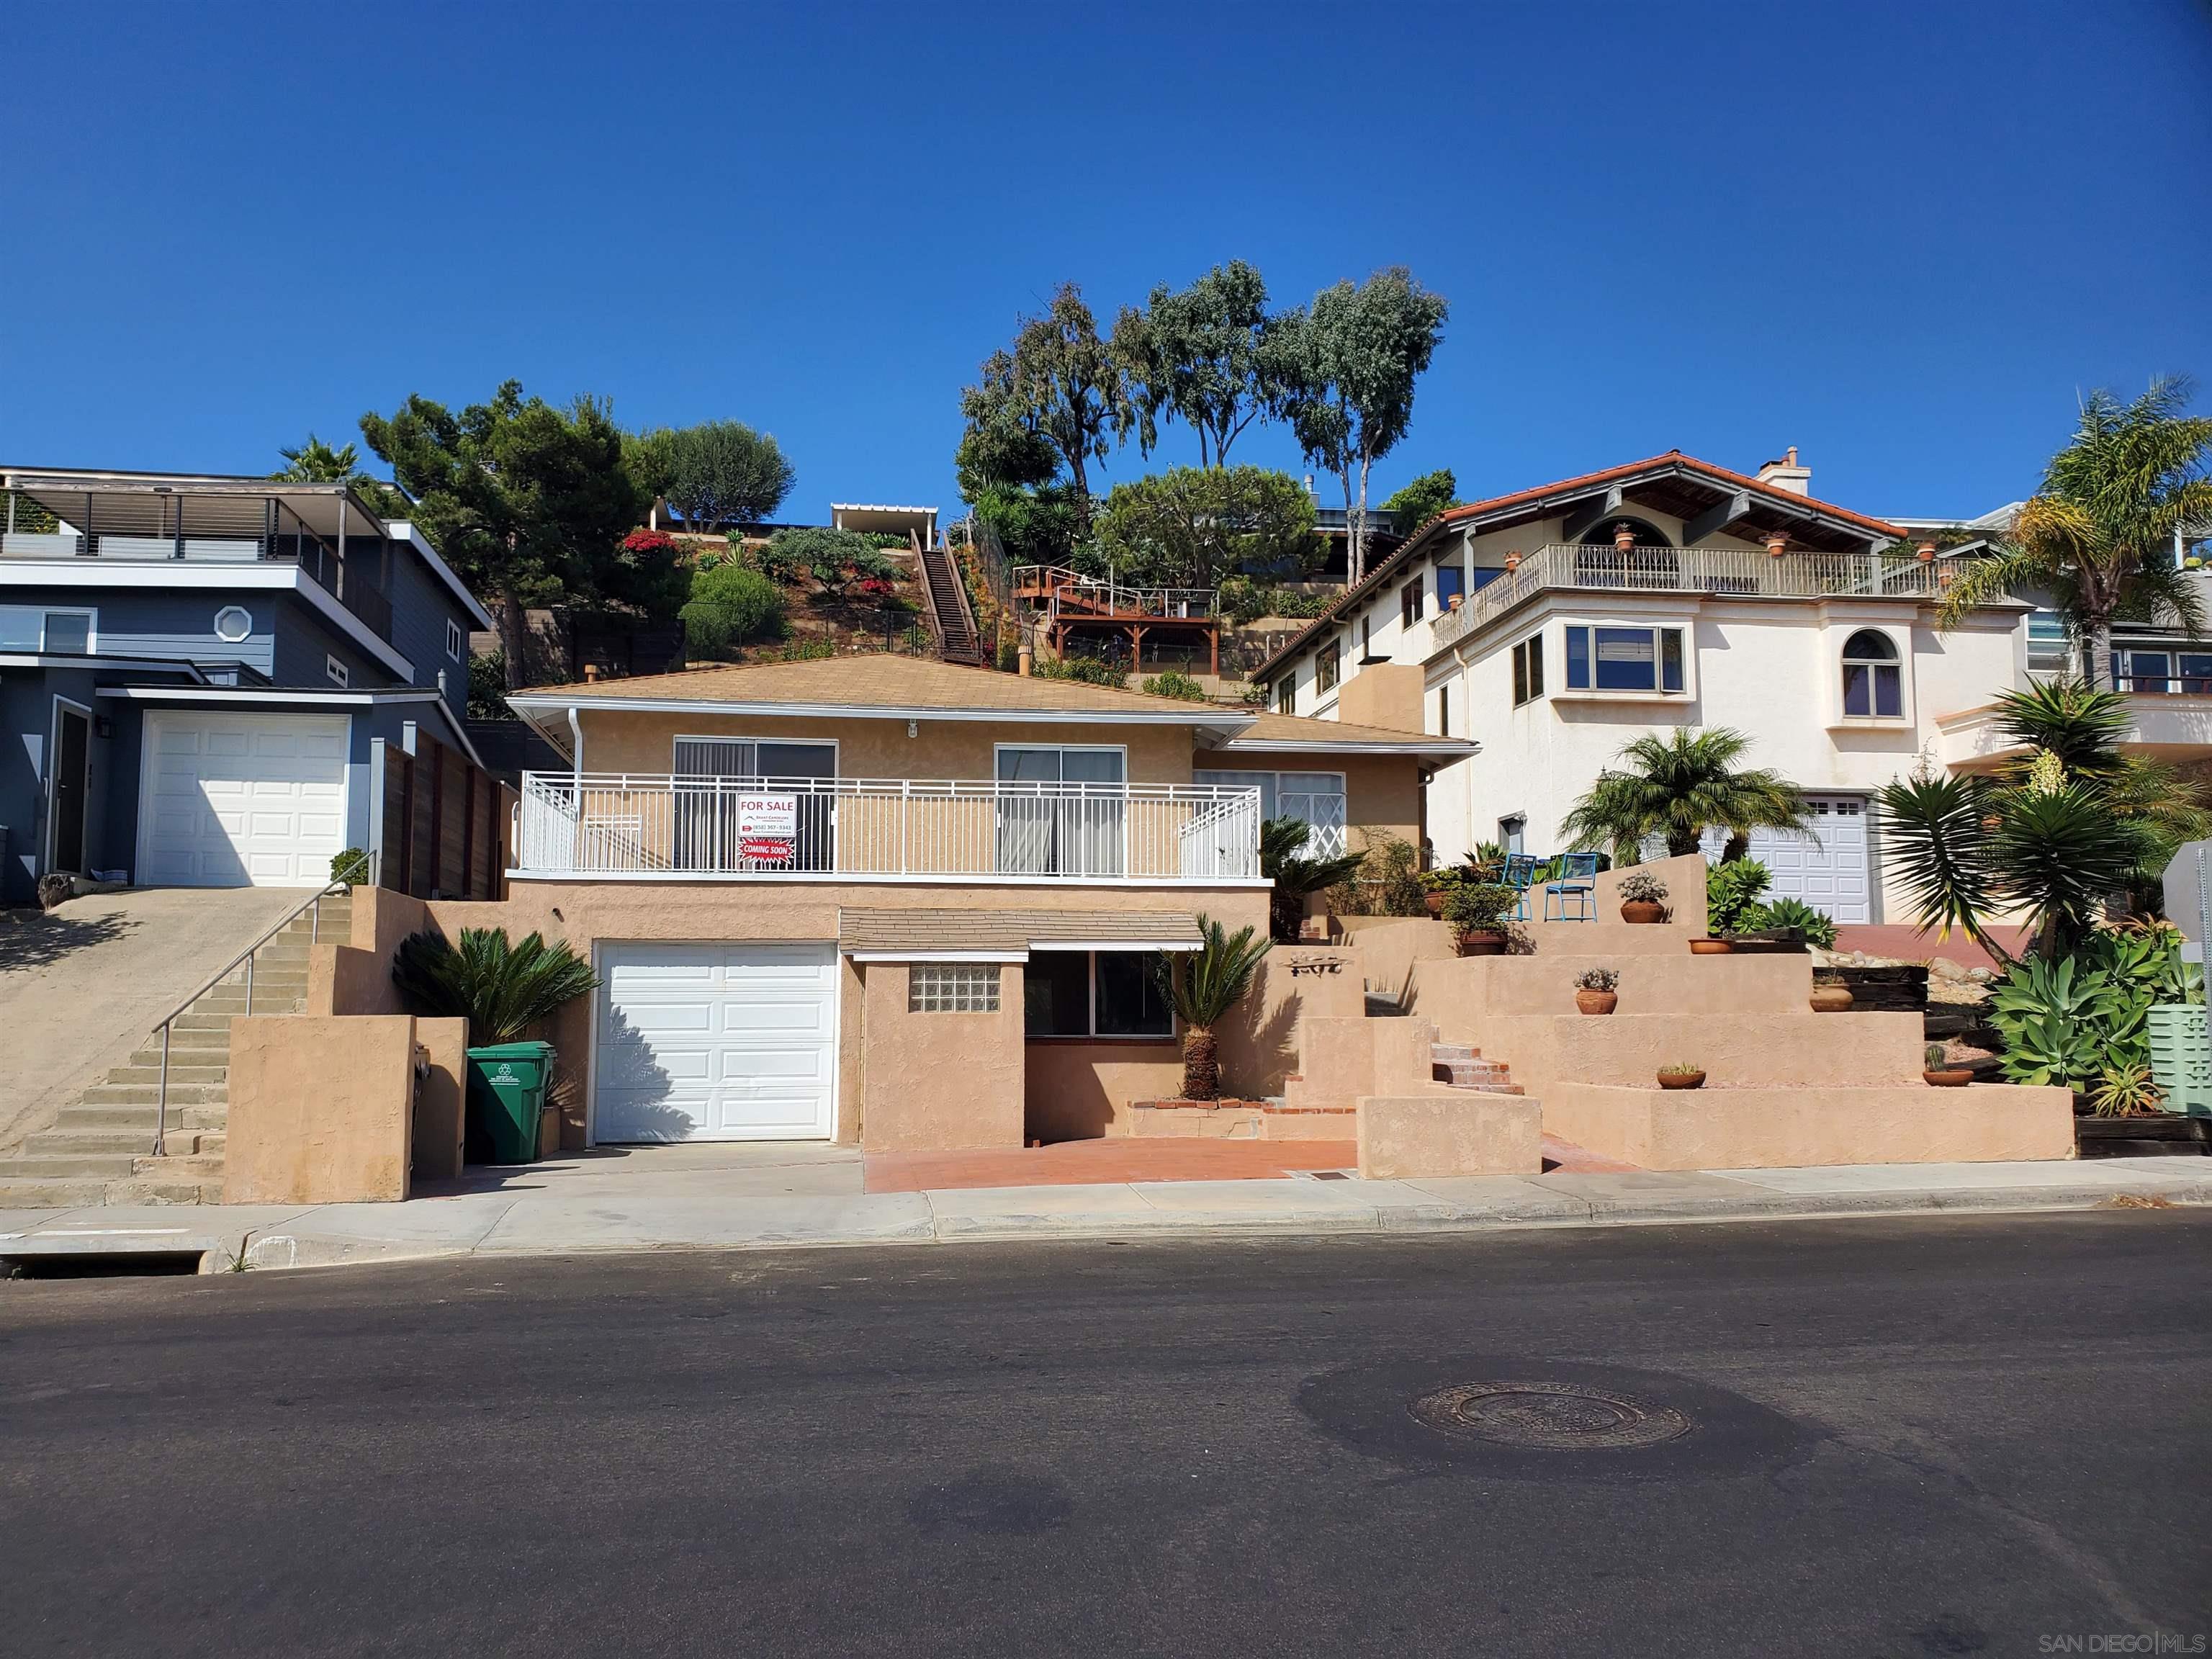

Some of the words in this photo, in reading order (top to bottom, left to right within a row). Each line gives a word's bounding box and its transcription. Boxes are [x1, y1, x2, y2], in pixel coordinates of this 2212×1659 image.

[741, 801, 763, 811] FOR
[767, 801, 793, 811] SALE
[744, 845, 769, 854] COMING
[770, 846, 788, 855] SOON
